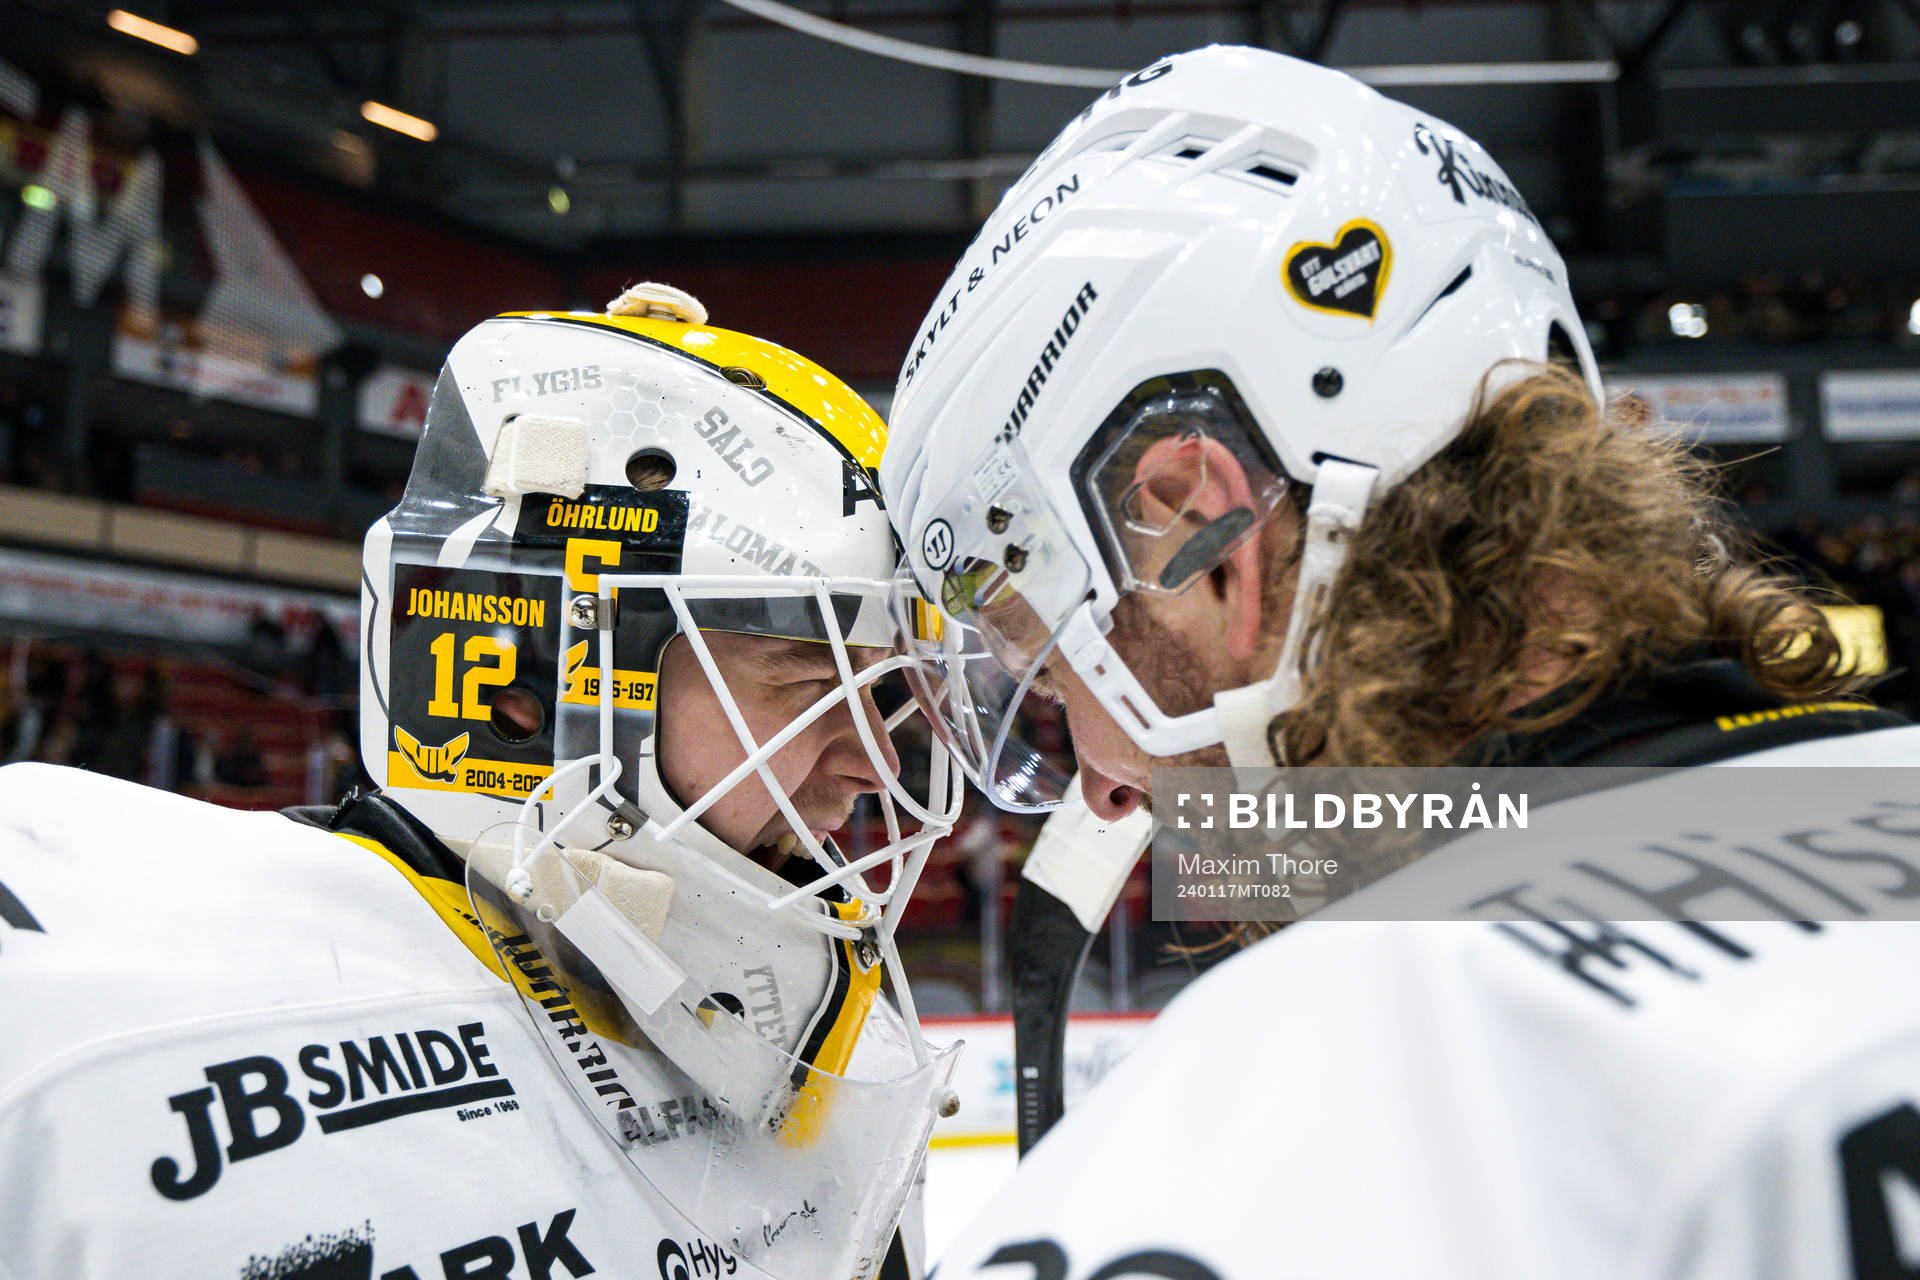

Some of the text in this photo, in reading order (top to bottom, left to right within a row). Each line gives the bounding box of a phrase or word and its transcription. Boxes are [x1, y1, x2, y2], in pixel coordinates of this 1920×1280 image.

[905, 173, 1081, 386] SKYLT & NEON
[491, 364, 603, 404] FLYGIS
[693, 405, 776, 488] SALO
[546, 497, 660, 533] ÖHRLUND
[406, 587, 546, 628] JOHANSSON
[428, 632, 517, 721] 12
[150, 1021, 500, 1202] JB SMIDE
[457, 1099, 520, 1122] Since 1969
